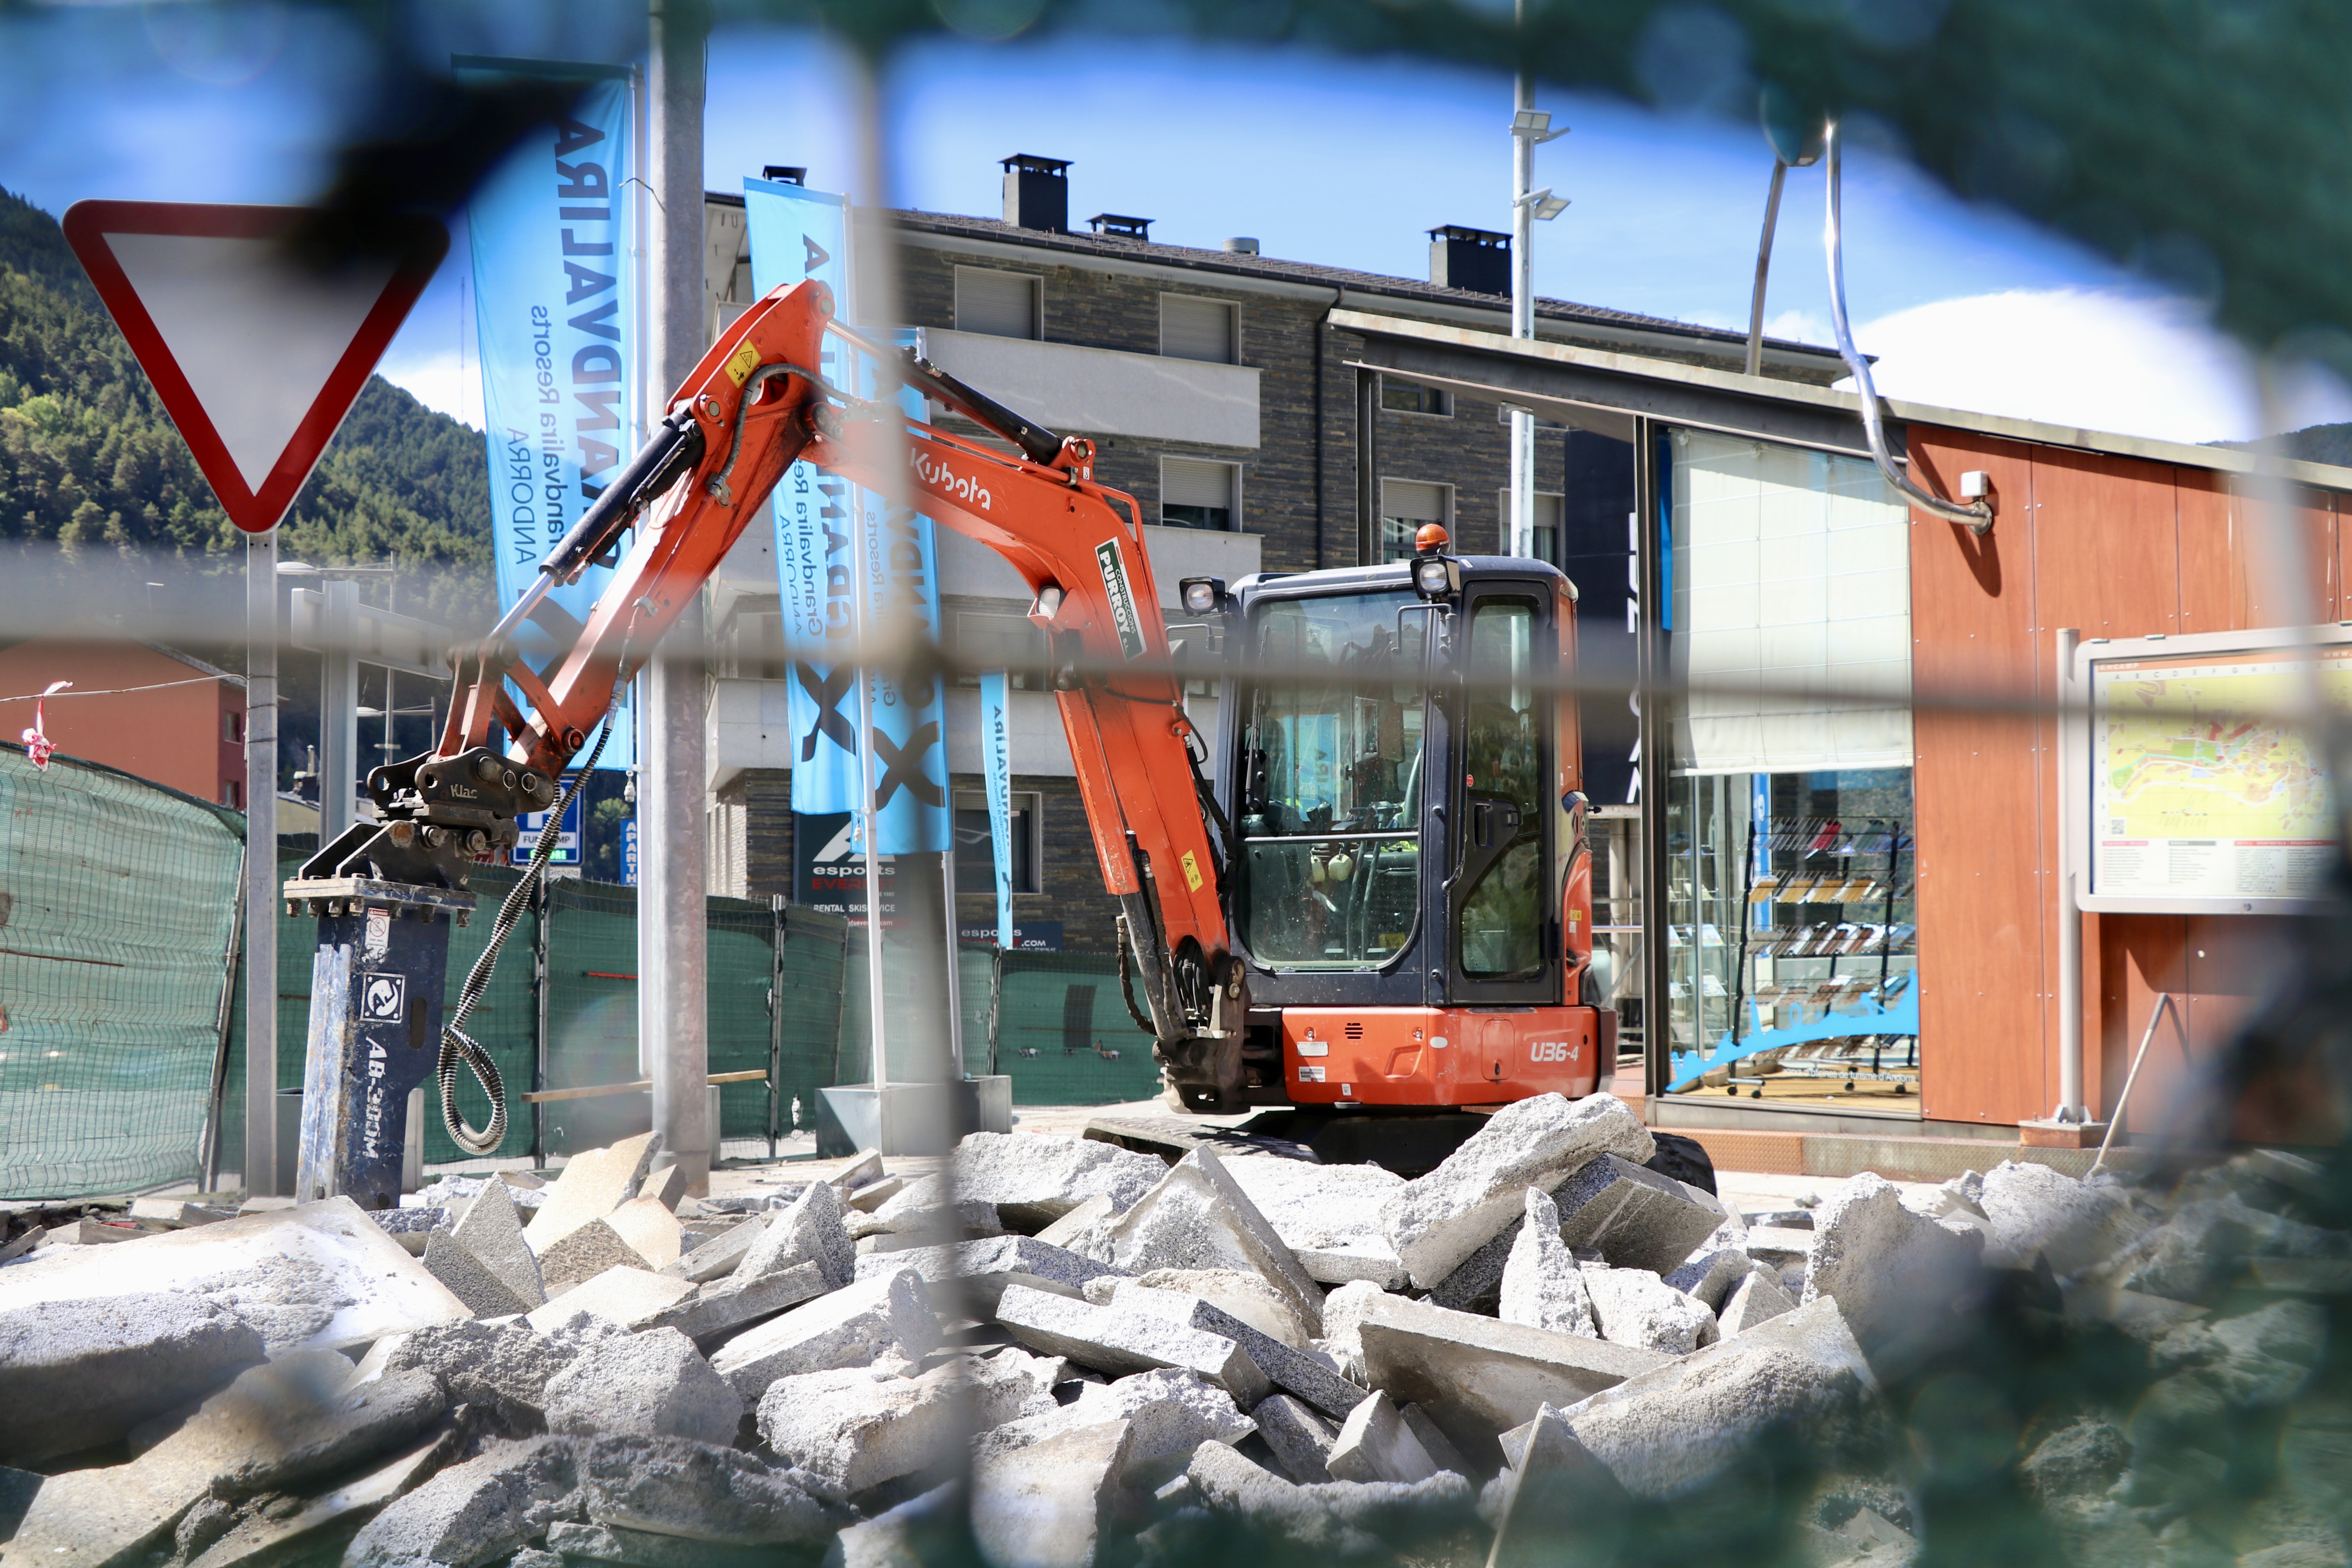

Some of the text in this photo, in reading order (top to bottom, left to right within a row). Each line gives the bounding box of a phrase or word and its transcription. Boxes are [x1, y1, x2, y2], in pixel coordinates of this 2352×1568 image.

[910, 447, 991, 510] Kubota
[1099, 550, 1131, 633] PURROY
[1116, 569, 1136, 634] CONSTRUCCIONS
[450, 784, 477, 799] Klac
[626, 822, 637, 886] APARTH
[813, 865, 895, 878] espots
[962, 929, 1022, 938] espos
[1531, 1042, 1579, 1062] U36-4
[1839, 1070, 1848, 1079] de
[1850, 1070, 1877, 1081] turisme
[1879, 1072, 1916, 1082] d'Andorra
